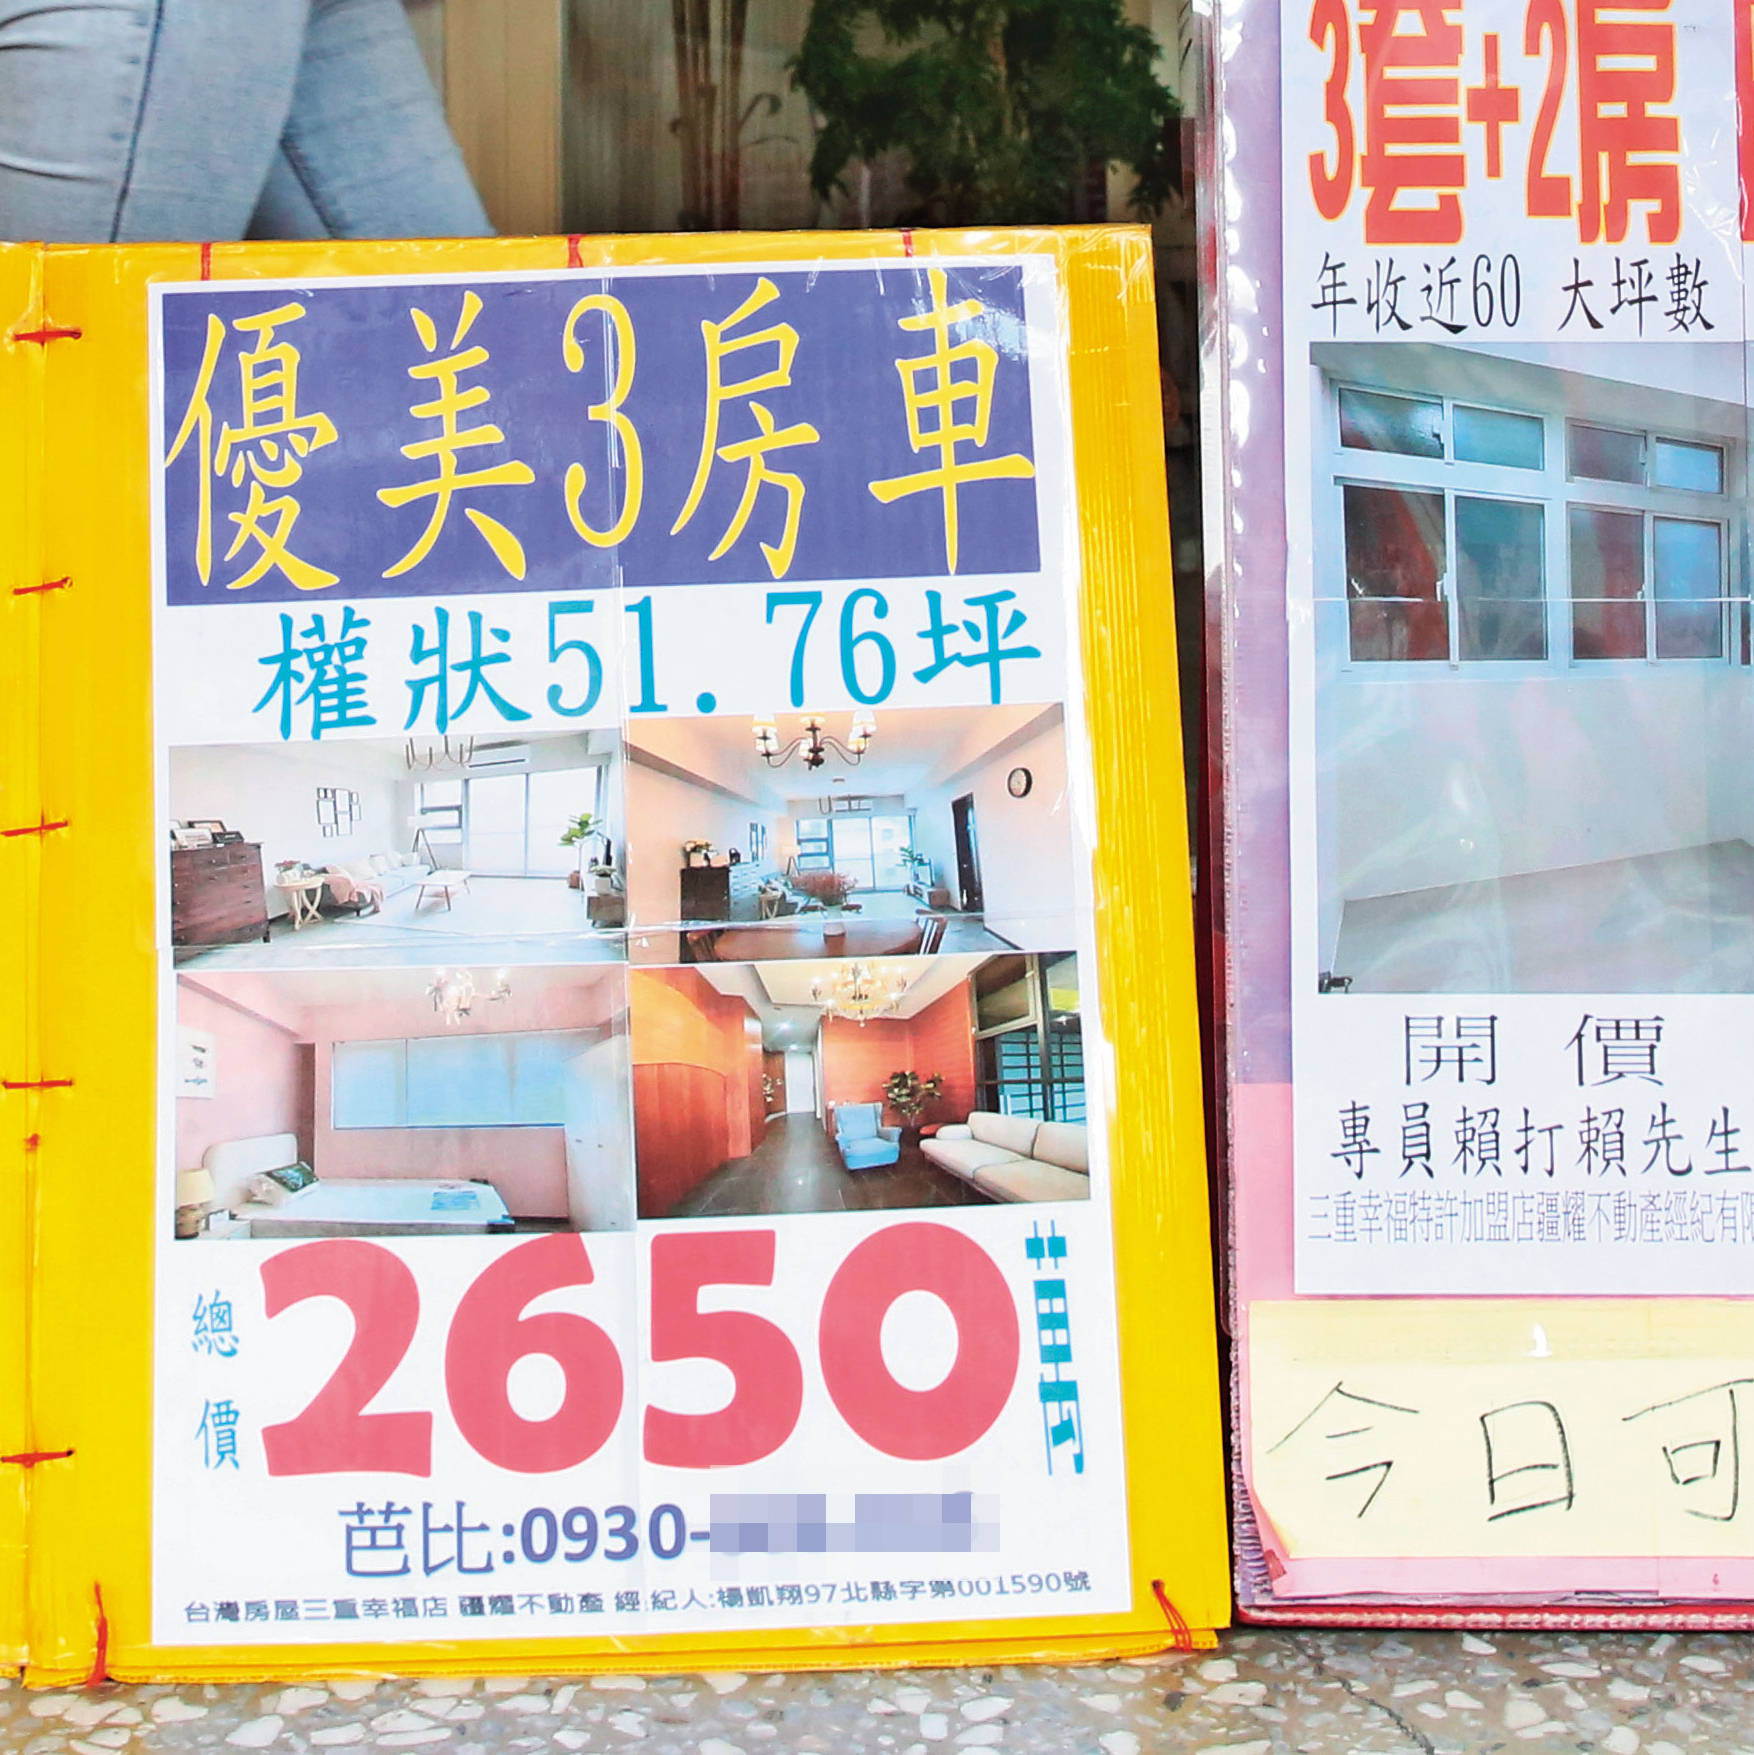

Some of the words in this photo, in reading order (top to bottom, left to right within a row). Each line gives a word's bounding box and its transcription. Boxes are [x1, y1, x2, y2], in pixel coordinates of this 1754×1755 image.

[1310, 249, 1521, 340] 年收近60
[1558, 256, 1716, 334] 大坪數
[163, 267, 1036, 592] 優美3房車
[257, 1219, 1023, 1480] 2650
